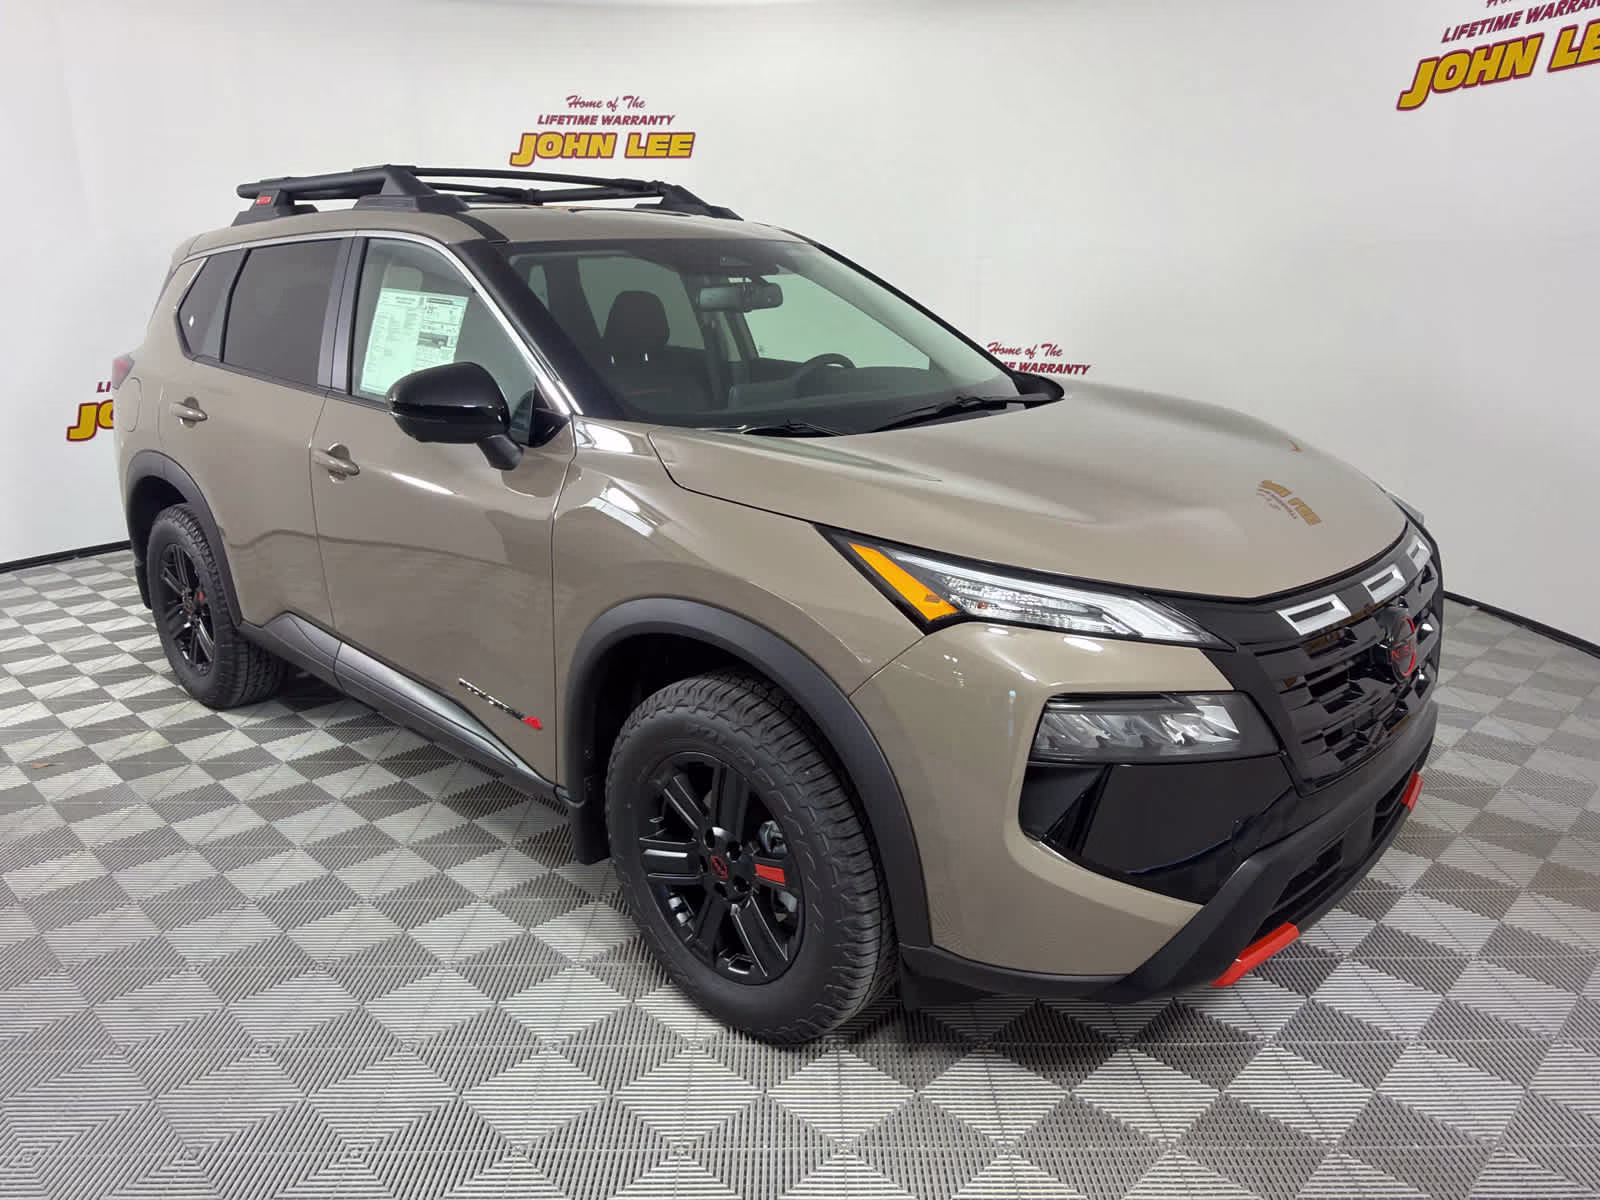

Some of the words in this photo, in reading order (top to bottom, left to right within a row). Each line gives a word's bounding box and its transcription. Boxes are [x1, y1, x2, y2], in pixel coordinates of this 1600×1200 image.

[1441, 10, 1523, 43] LIFETIME
[1396, 32, 1544, 111] JOHN
[566, 95, 603, 109] Home
[606, 96, 619, 112] of
[622, 95, 646, 109] The
[537, 115, 599, 125] LIFETIME
[601, 115, 675, 125] WARRANTY
[509, 131, 618, 167] JOHN
[624, 132, 696, 158] LEE
[987, 342, 1022, 356] Home
[1024, 344, 1038, 359] of
[1041, 343, 1063, 357] The
[1018, 362, 1091, 375] WARRANTY
